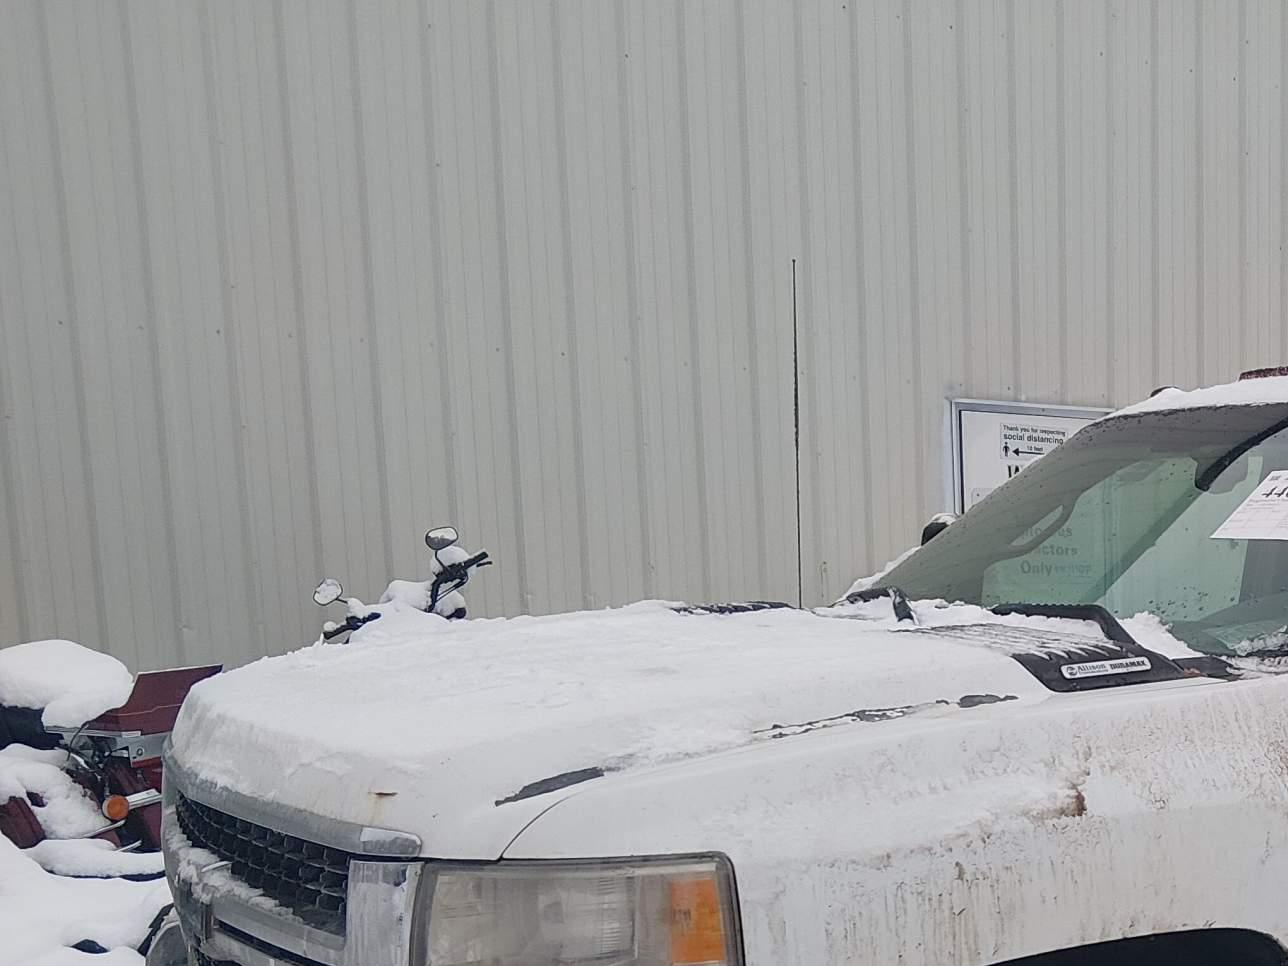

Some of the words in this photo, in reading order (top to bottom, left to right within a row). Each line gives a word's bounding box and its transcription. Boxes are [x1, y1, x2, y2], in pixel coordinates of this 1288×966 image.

[1003, 424, 1019, 432] Thank
[1003, 433, 1025, 441] social
[1026, 434, 1064, 445] distancing
[1020, 560, 1051, 576] Only
[1077, 663, 1107, 672] Allison
[1109, 660, 1146, 670] DURAMAX
